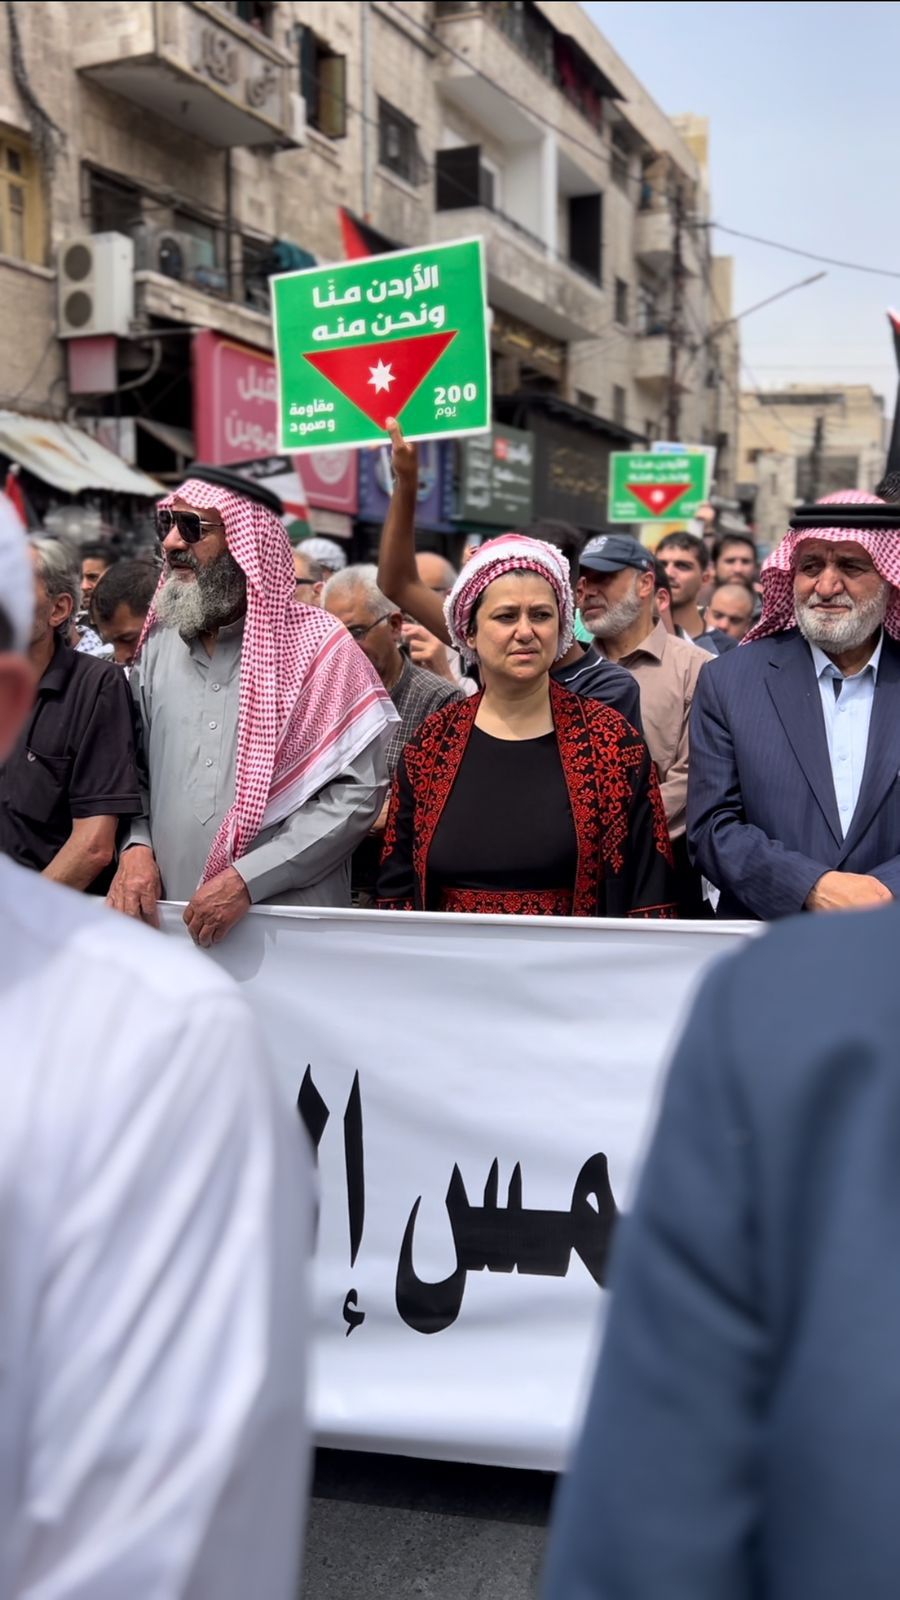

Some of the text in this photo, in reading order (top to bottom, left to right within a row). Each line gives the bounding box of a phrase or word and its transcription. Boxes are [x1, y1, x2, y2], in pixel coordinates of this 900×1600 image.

[366, 264, 439, 303] الأردن
[312, 303, 445, 341] ونحن منه
[434, 383, 477, 405] 200
[289, 399, 334, 417] مقاومة
[435, 405, 457, 419] يوم
[290, 418, 336, 435] وصمود
